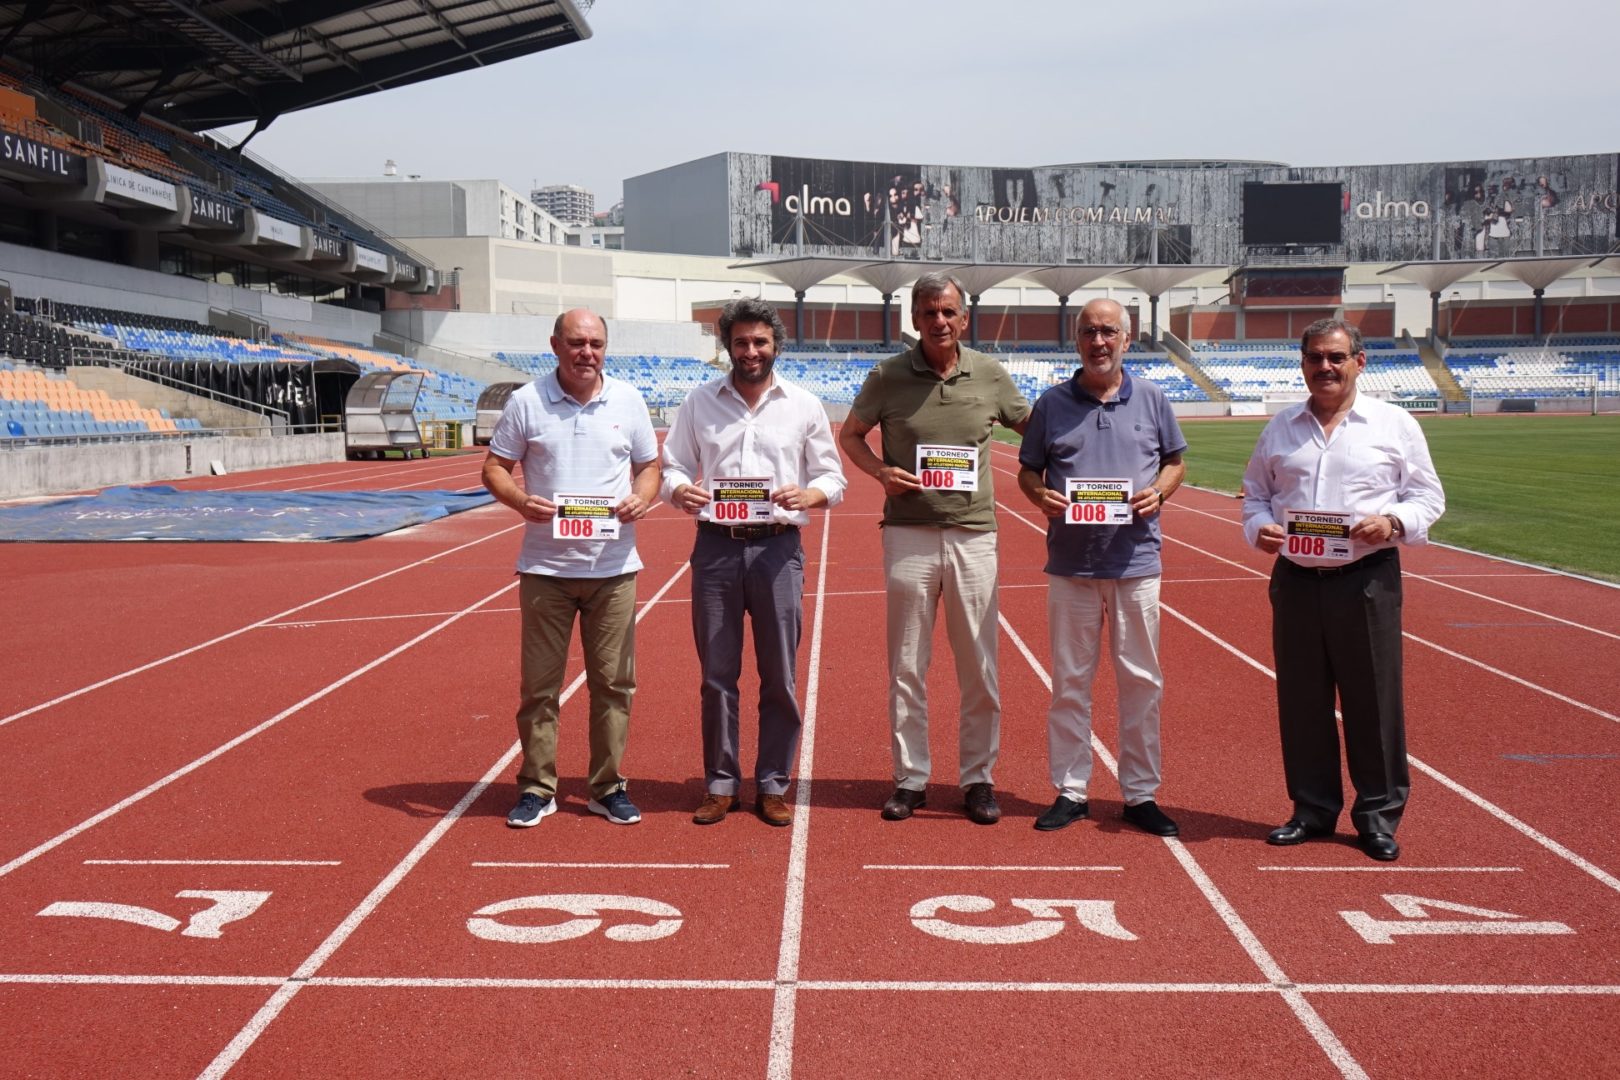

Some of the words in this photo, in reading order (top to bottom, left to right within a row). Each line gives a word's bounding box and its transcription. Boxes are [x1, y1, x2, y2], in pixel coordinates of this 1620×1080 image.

[5, 135, 68, 175] SANFIL
[106, 174, 127, 187] LINICA
[193, 196, 234, 225] SANFIL
[785, 184, 851, 216] alma
[1356, 190, 1429, 219] alma
[975, 206, 1049, 223] APOIEM
[1055, 207, 1105, 224] COM
[313, 235, 342, 257] SANFIL
[936, 450, 969, 458] TORNEIO
[922, 470, 954, 488] 008
[715, 502, 749, 520] 008
[1072, 503, 1106, 522] 008
[1305, 515, 1344, 524] TORNEIO
[559, 518, 593, 537] 008
[1288, 535, 1325, 557] 008
[37, 889, 273, 939] 7
[466, 893, 684, 944] 6
[909, 894, 1140, 944] 5
[1338, 893, 1577, 945] 4
